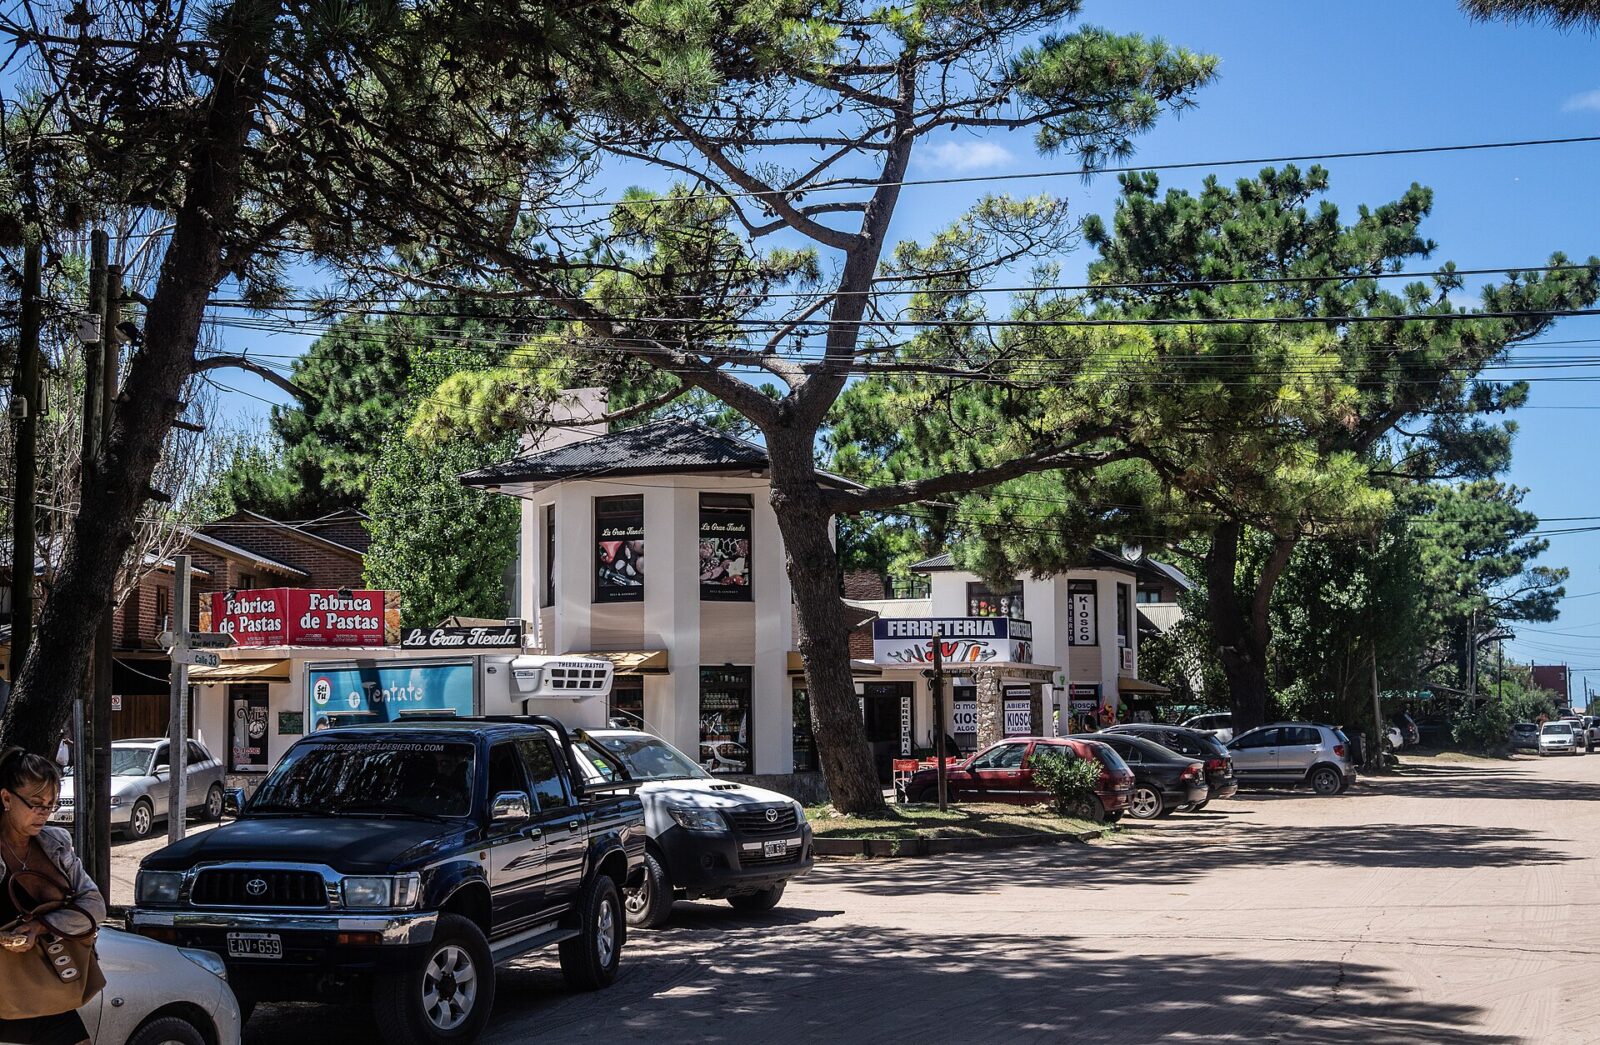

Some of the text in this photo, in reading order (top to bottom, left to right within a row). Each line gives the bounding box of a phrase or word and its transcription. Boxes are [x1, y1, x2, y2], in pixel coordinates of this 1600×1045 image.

[226, 597, 276, 615] Fabrica
[309, 593, 371, 611] Fabrica
[219, 616, 282, 634] de Pastas
[300, 612, 379, 630] de Pastas
[1079, 596, 1090, 641] KIOSCO
[402, 629, 427, 646] La
[429, 629, 466, 646] Gran
[467, 628, 517, 645] Tienda
[887, 620, 996, 637] FERRETERIA
[195, 654, 217, 666] Calle 33
[317, 684, 328, 693] Sei
[902, 698, 910, 755] FERRETERIA
[258, 940, 280, 953] 659
